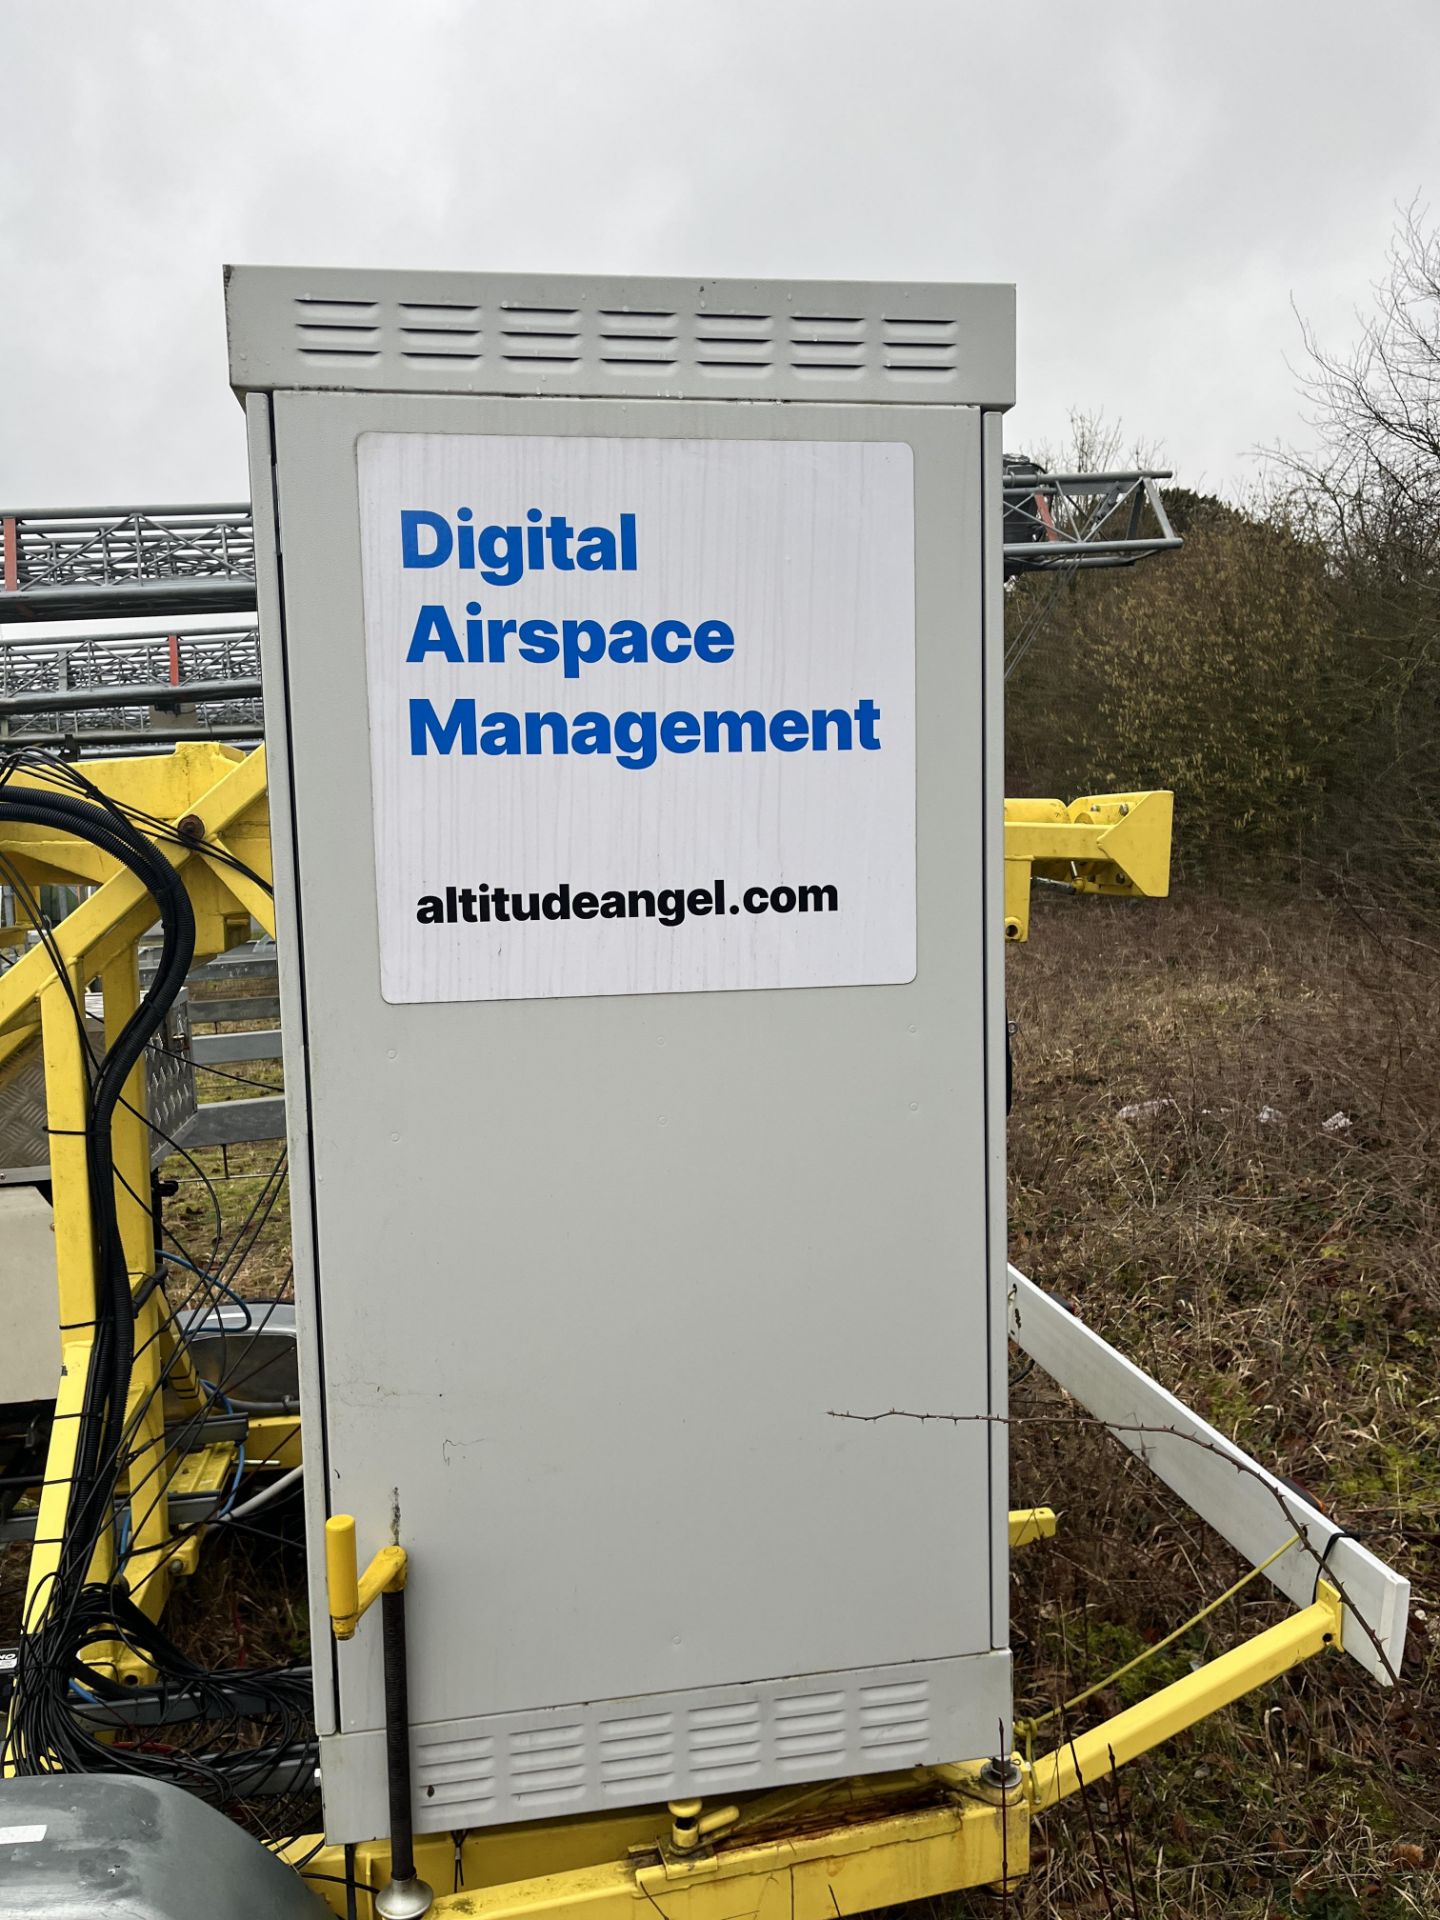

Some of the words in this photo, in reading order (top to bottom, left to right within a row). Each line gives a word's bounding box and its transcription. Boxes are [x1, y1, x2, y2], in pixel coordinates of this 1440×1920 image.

[400, 506, 638, 587] Digital
[406, 601, 735, 679] Airspace
[408, 698, 882, 770] Management
[416, 879, 839, 927] altitudeangel.com
